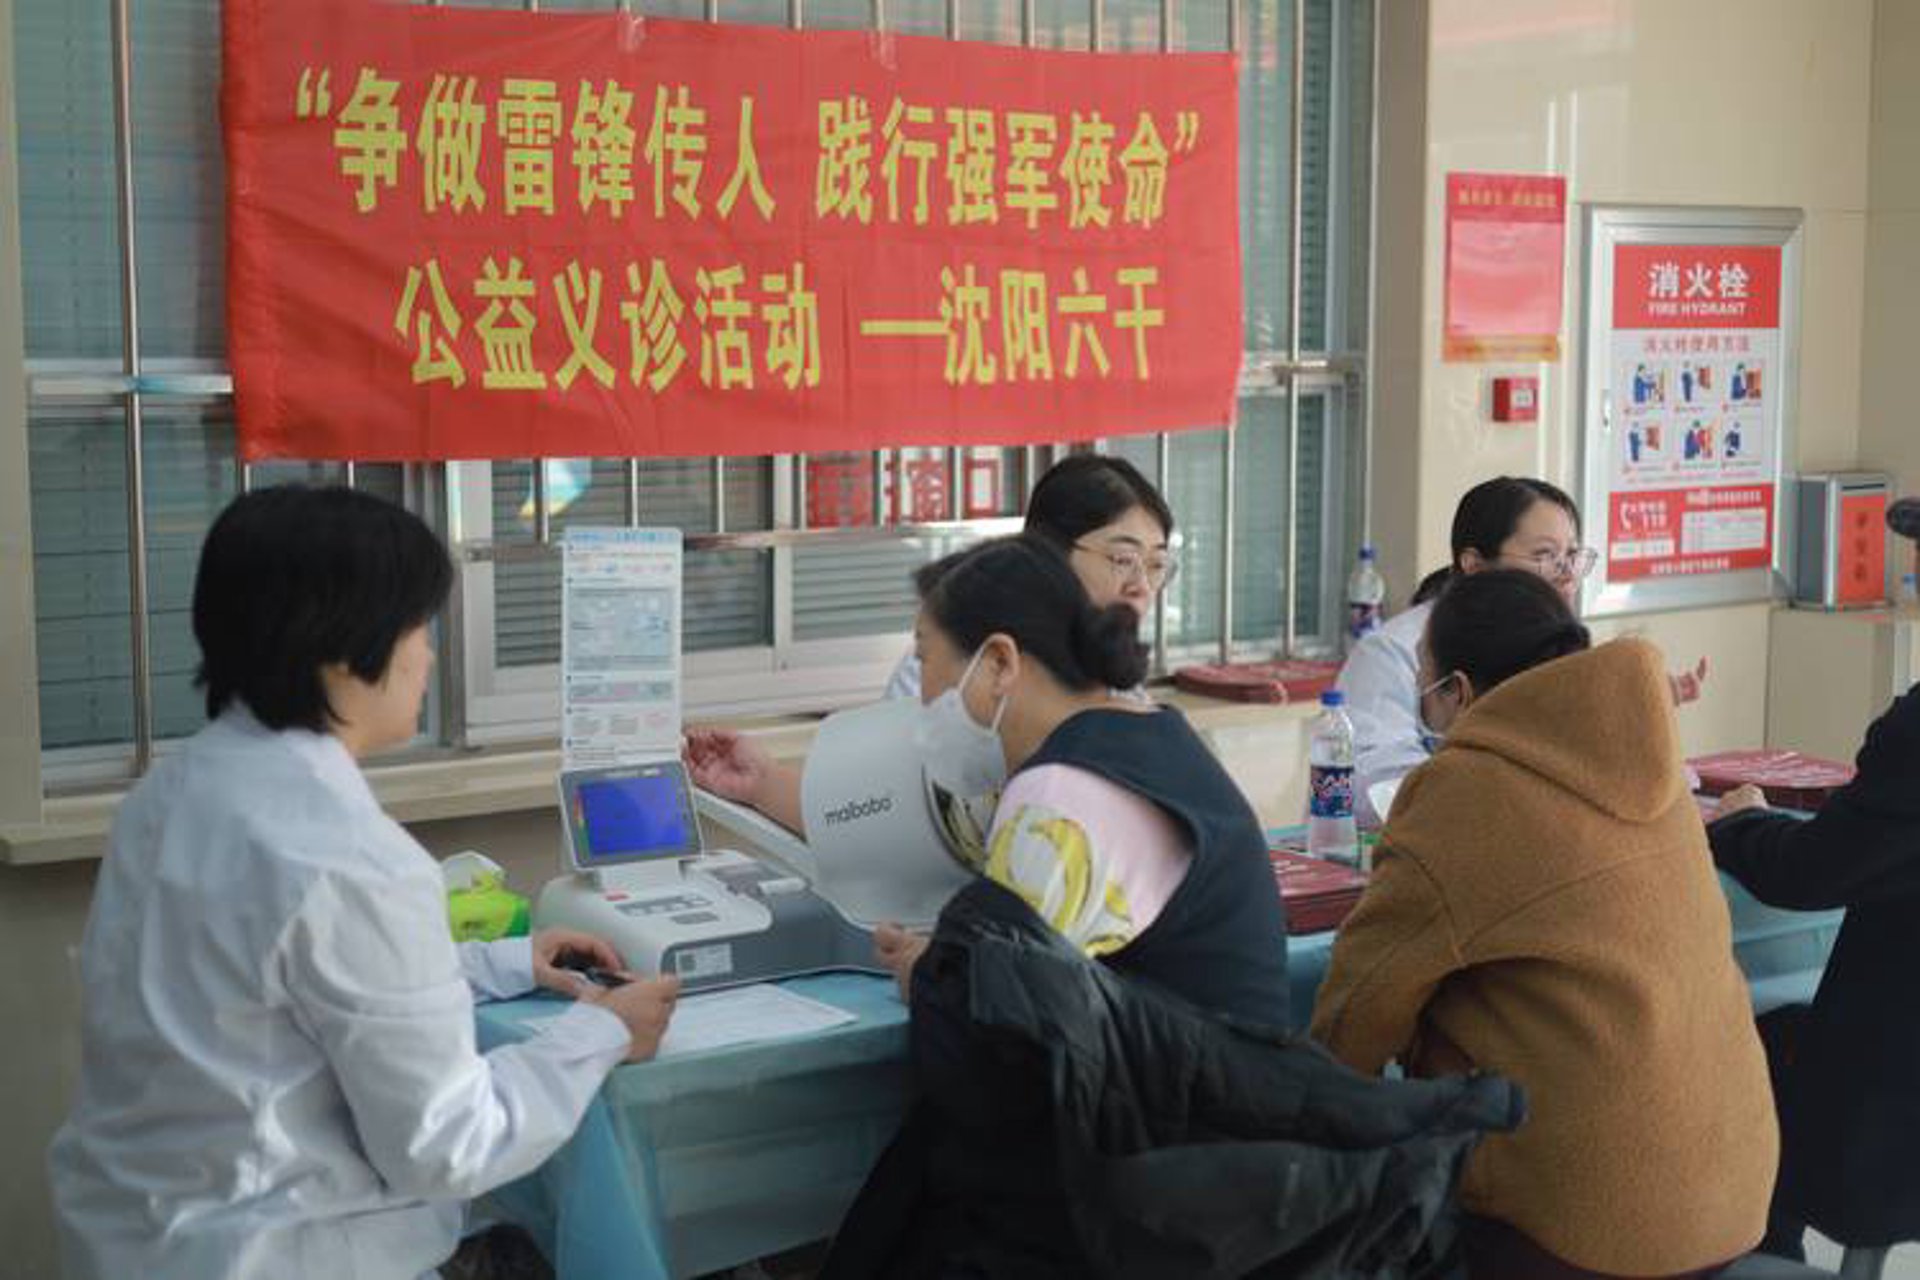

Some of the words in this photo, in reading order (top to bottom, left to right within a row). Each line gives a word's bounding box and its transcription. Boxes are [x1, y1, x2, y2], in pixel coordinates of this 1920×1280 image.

[296, 68, 776, 222] “争做雷锋传人
[815, 96, 1200, 229] 践行强军使命”
[1648, 261, 1749, 298] 消火栓
[1648, 302, 1677, 315] FIRE
[1681, 302, 1746, 315] HYDRANT
[394, 255, 821, 393] 公益义诊活动
